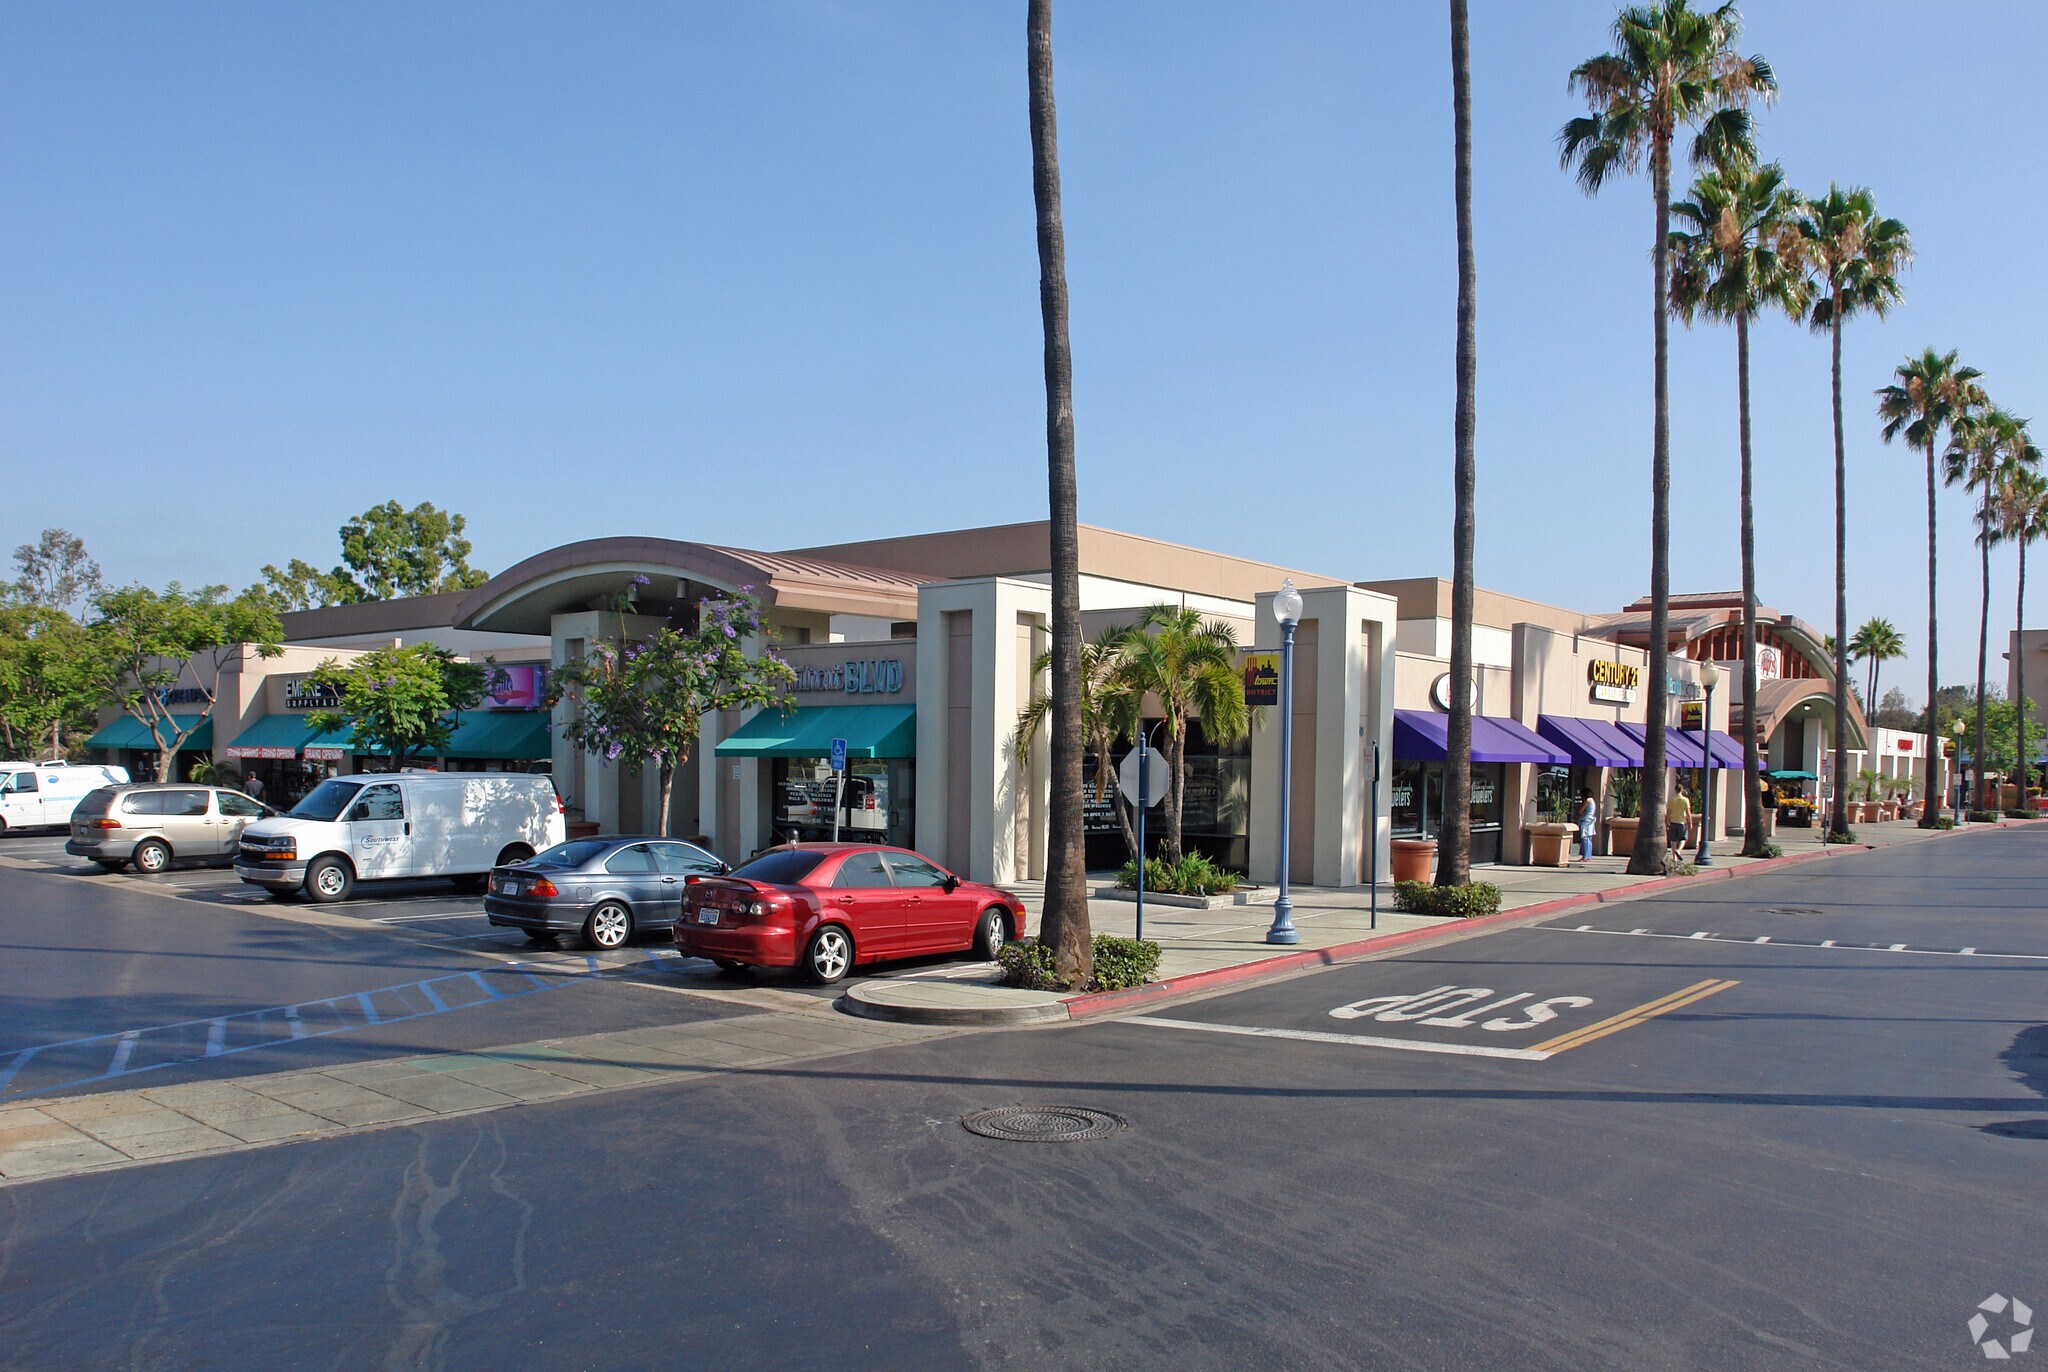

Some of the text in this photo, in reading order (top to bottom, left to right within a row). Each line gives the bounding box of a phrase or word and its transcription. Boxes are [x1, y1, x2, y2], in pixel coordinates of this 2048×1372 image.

[844, 659, 904, 693] BLVD
[1593, 659, 1631, 686] CENTURY
[1631, 666, 1639, 687] 21
[286, 699, 319, 707] SUPPLY
[226, 747, 296, 758] GRAND OPENING GRAND OPENING
[305, 749, 344, 759] GRAND OPENING
[1392, 789, 1411, 807] welers
[1469, 788, 1493, 804] Jewelers
[1328, 985, 1594, 1032] STOP
